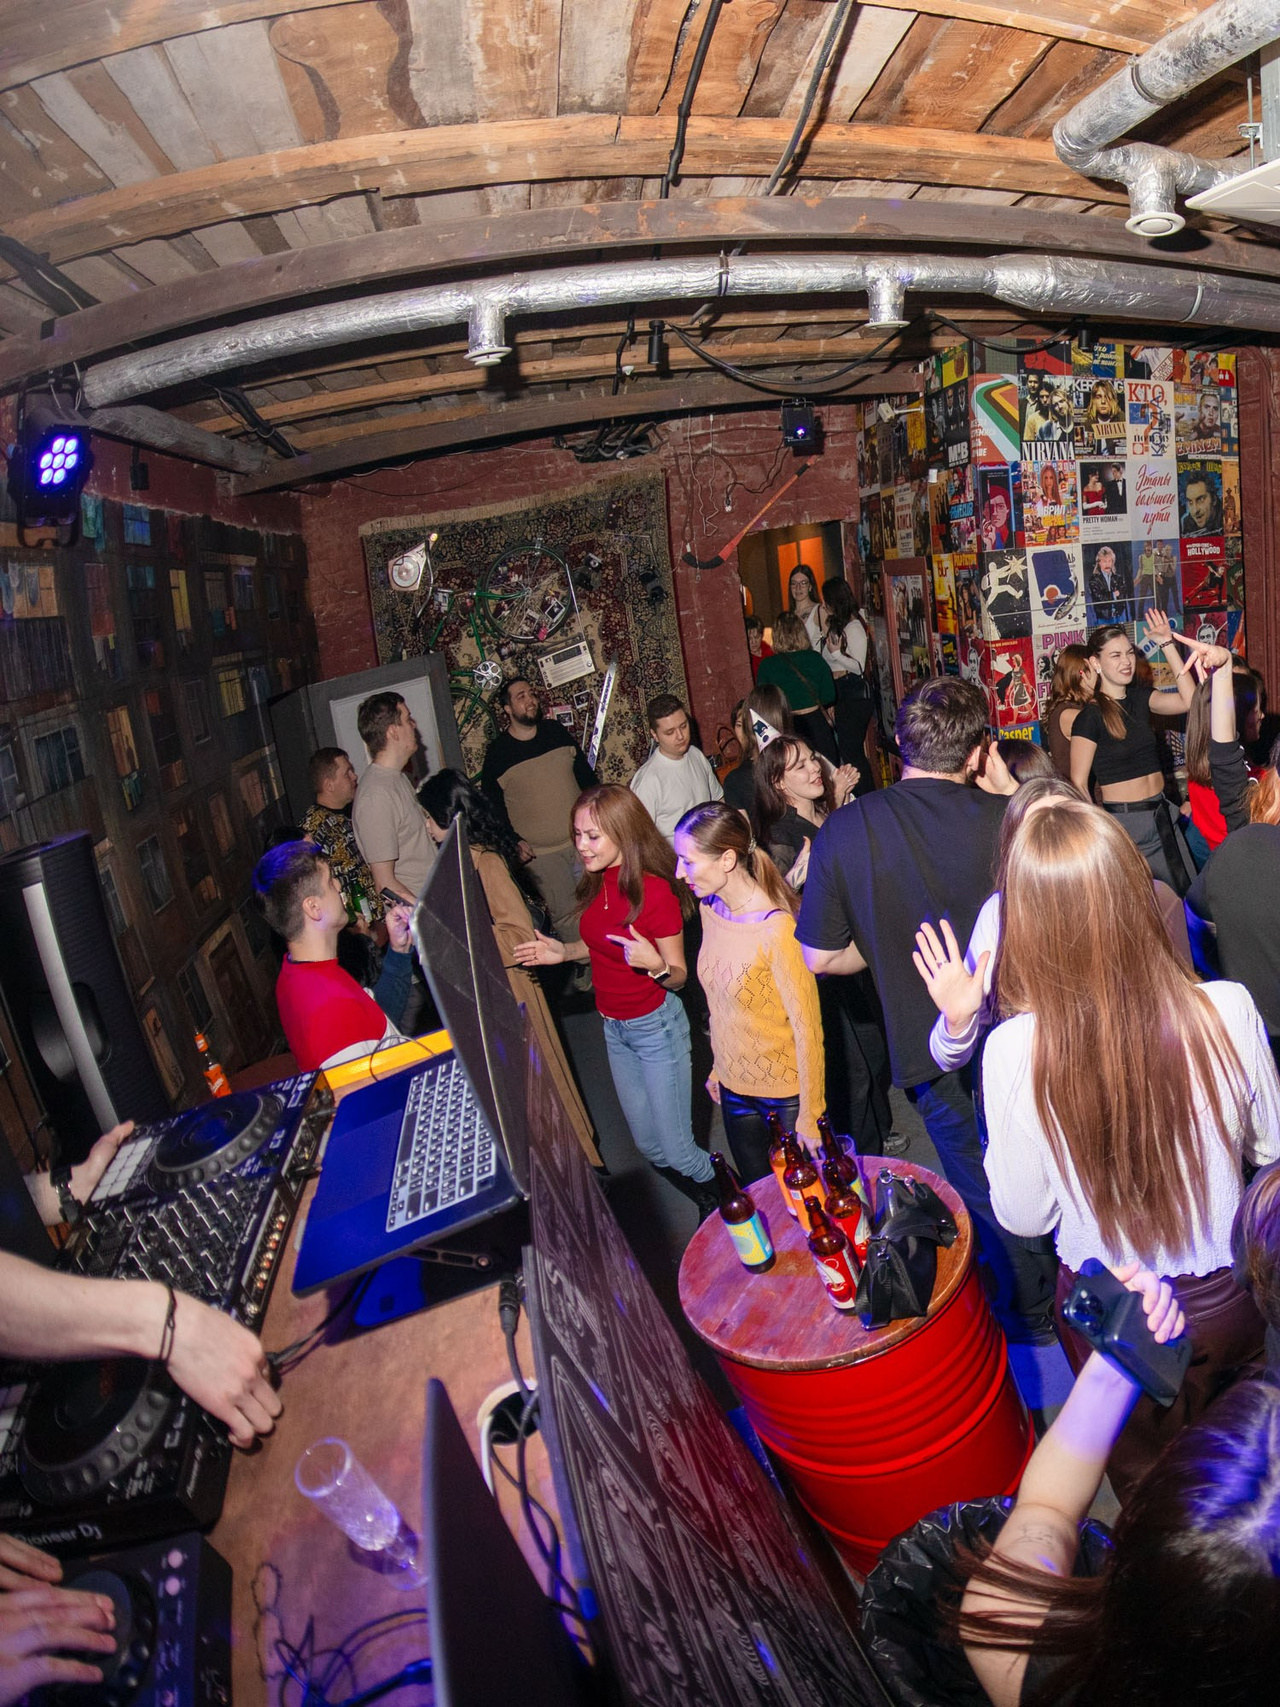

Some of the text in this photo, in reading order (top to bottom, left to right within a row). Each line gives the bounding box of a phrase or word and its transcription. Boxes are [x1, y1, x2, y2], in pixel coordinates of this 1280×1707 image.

[1072, 379, 1125, 394] KERNG
[1021, 441, 1075, 460] NIRVANA
[1135, 463, 1172, 491] Этапы
[1135, 486, 1176, 506] большого
[1142, 506, 1171, 535] пути
[1187, 546, 1220, 557] HOLLYWOOD
[1042, 629, 1086, 650] PINK
